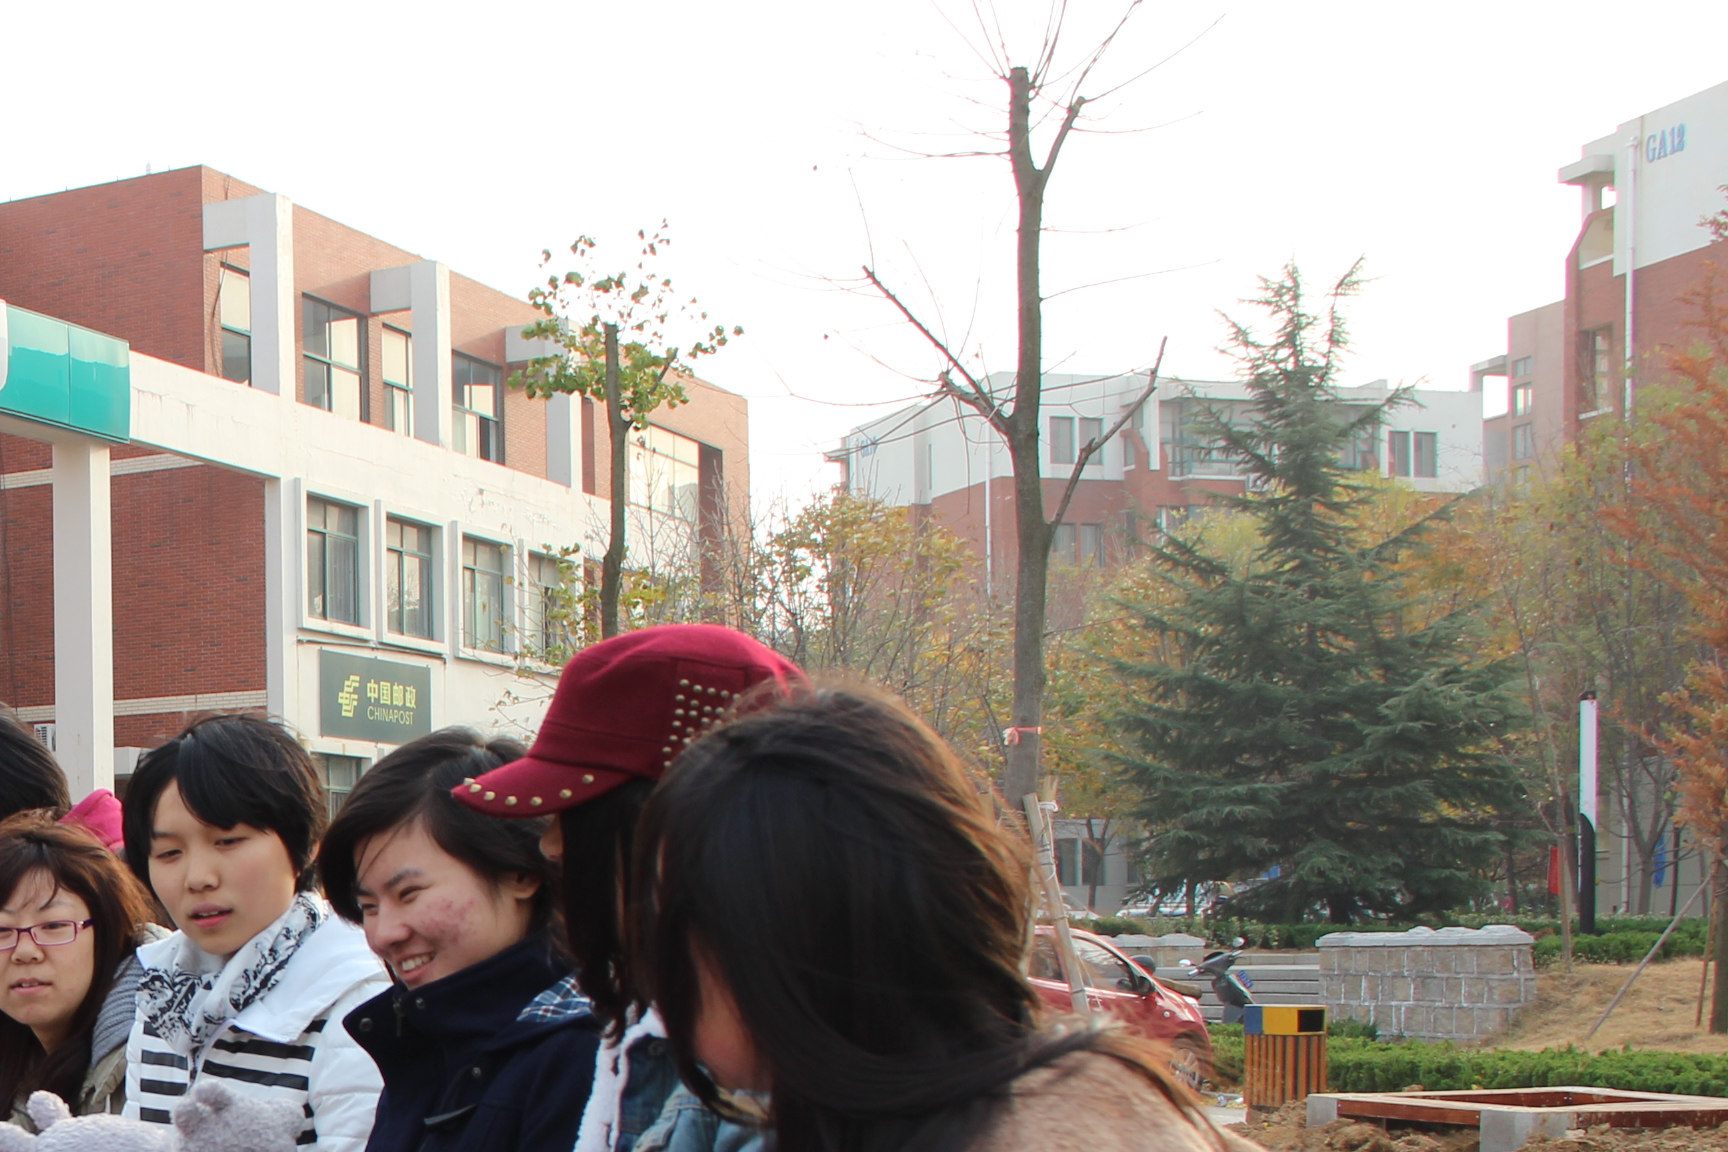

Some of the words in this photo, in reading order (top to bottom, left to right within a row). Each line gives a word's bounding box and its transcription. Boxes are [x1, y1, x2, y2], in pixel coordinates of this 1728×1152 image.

[1645, 123, 1686, 163] GA12
[367, 679, 416, 709] 中国邮政
